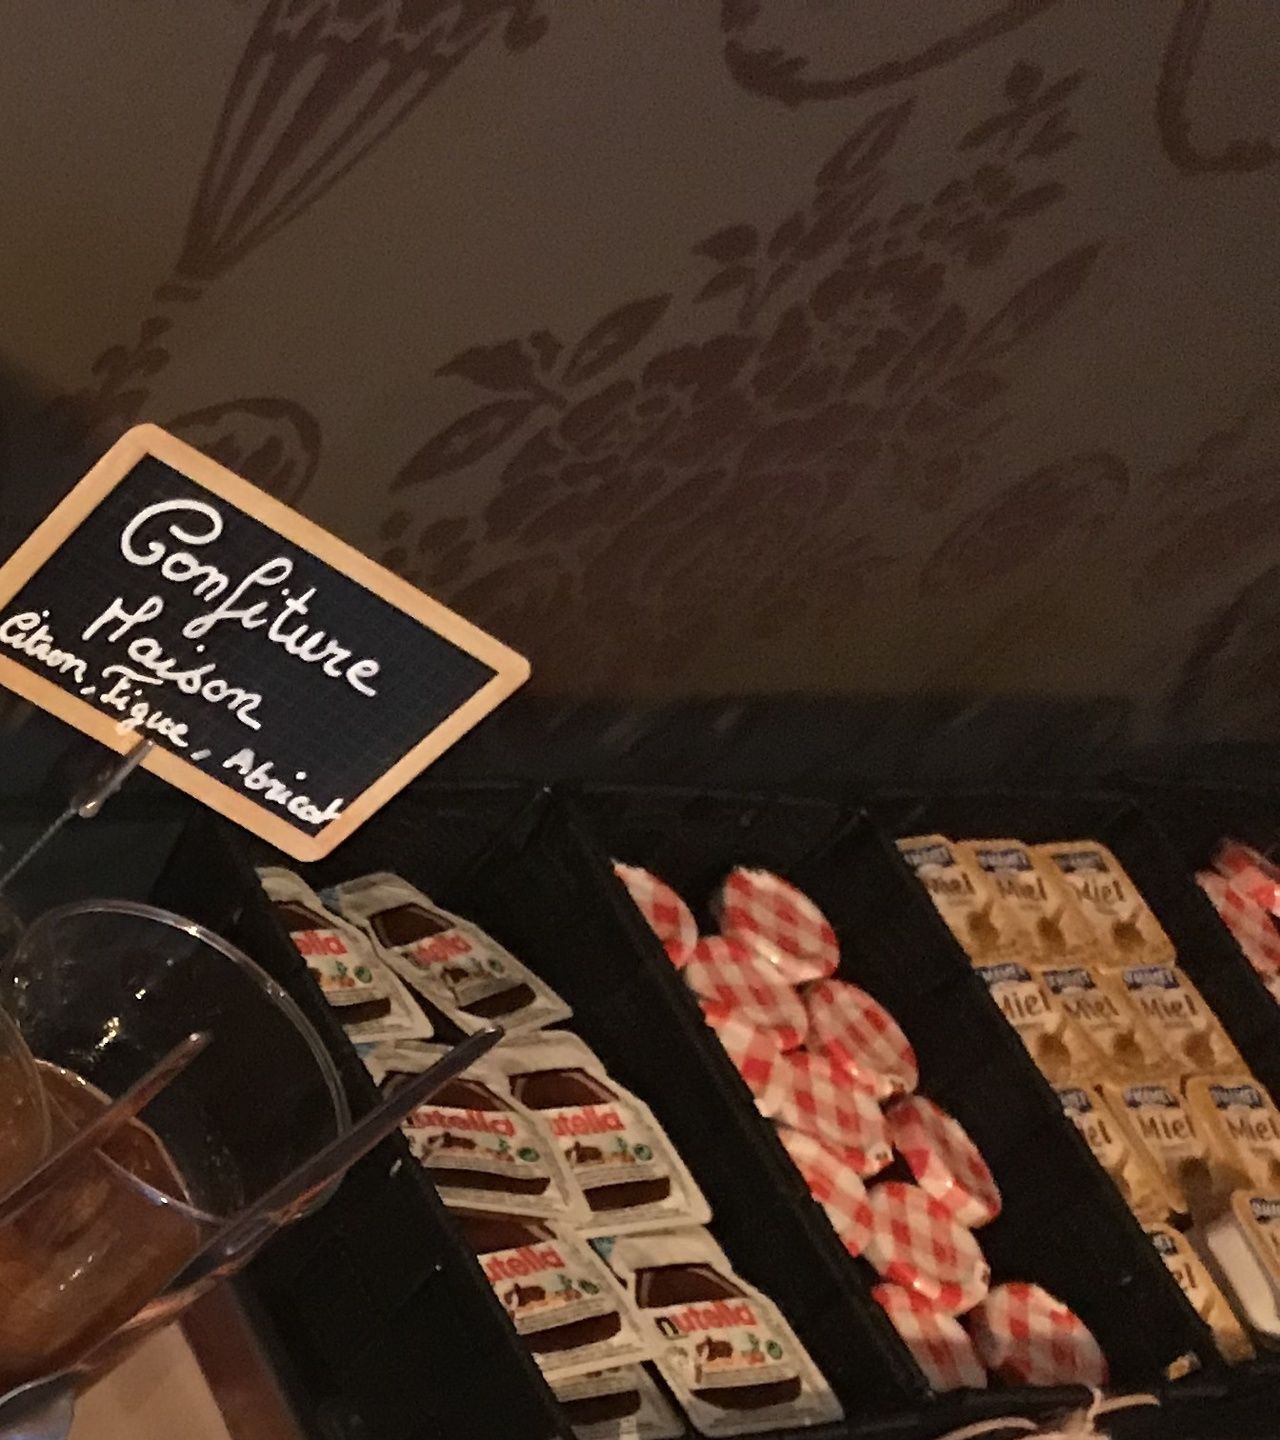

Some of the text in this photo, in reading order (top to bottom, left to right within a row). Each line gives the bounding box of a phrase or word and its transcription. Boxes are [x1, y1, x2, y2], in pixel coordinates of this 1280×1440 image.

[120, 499, 380, 697] Confiture
[82, 596, 263, 731] Maison
[224, 748, 342, 825] Abricot
[656, 1300, 759, 1338] nutella
